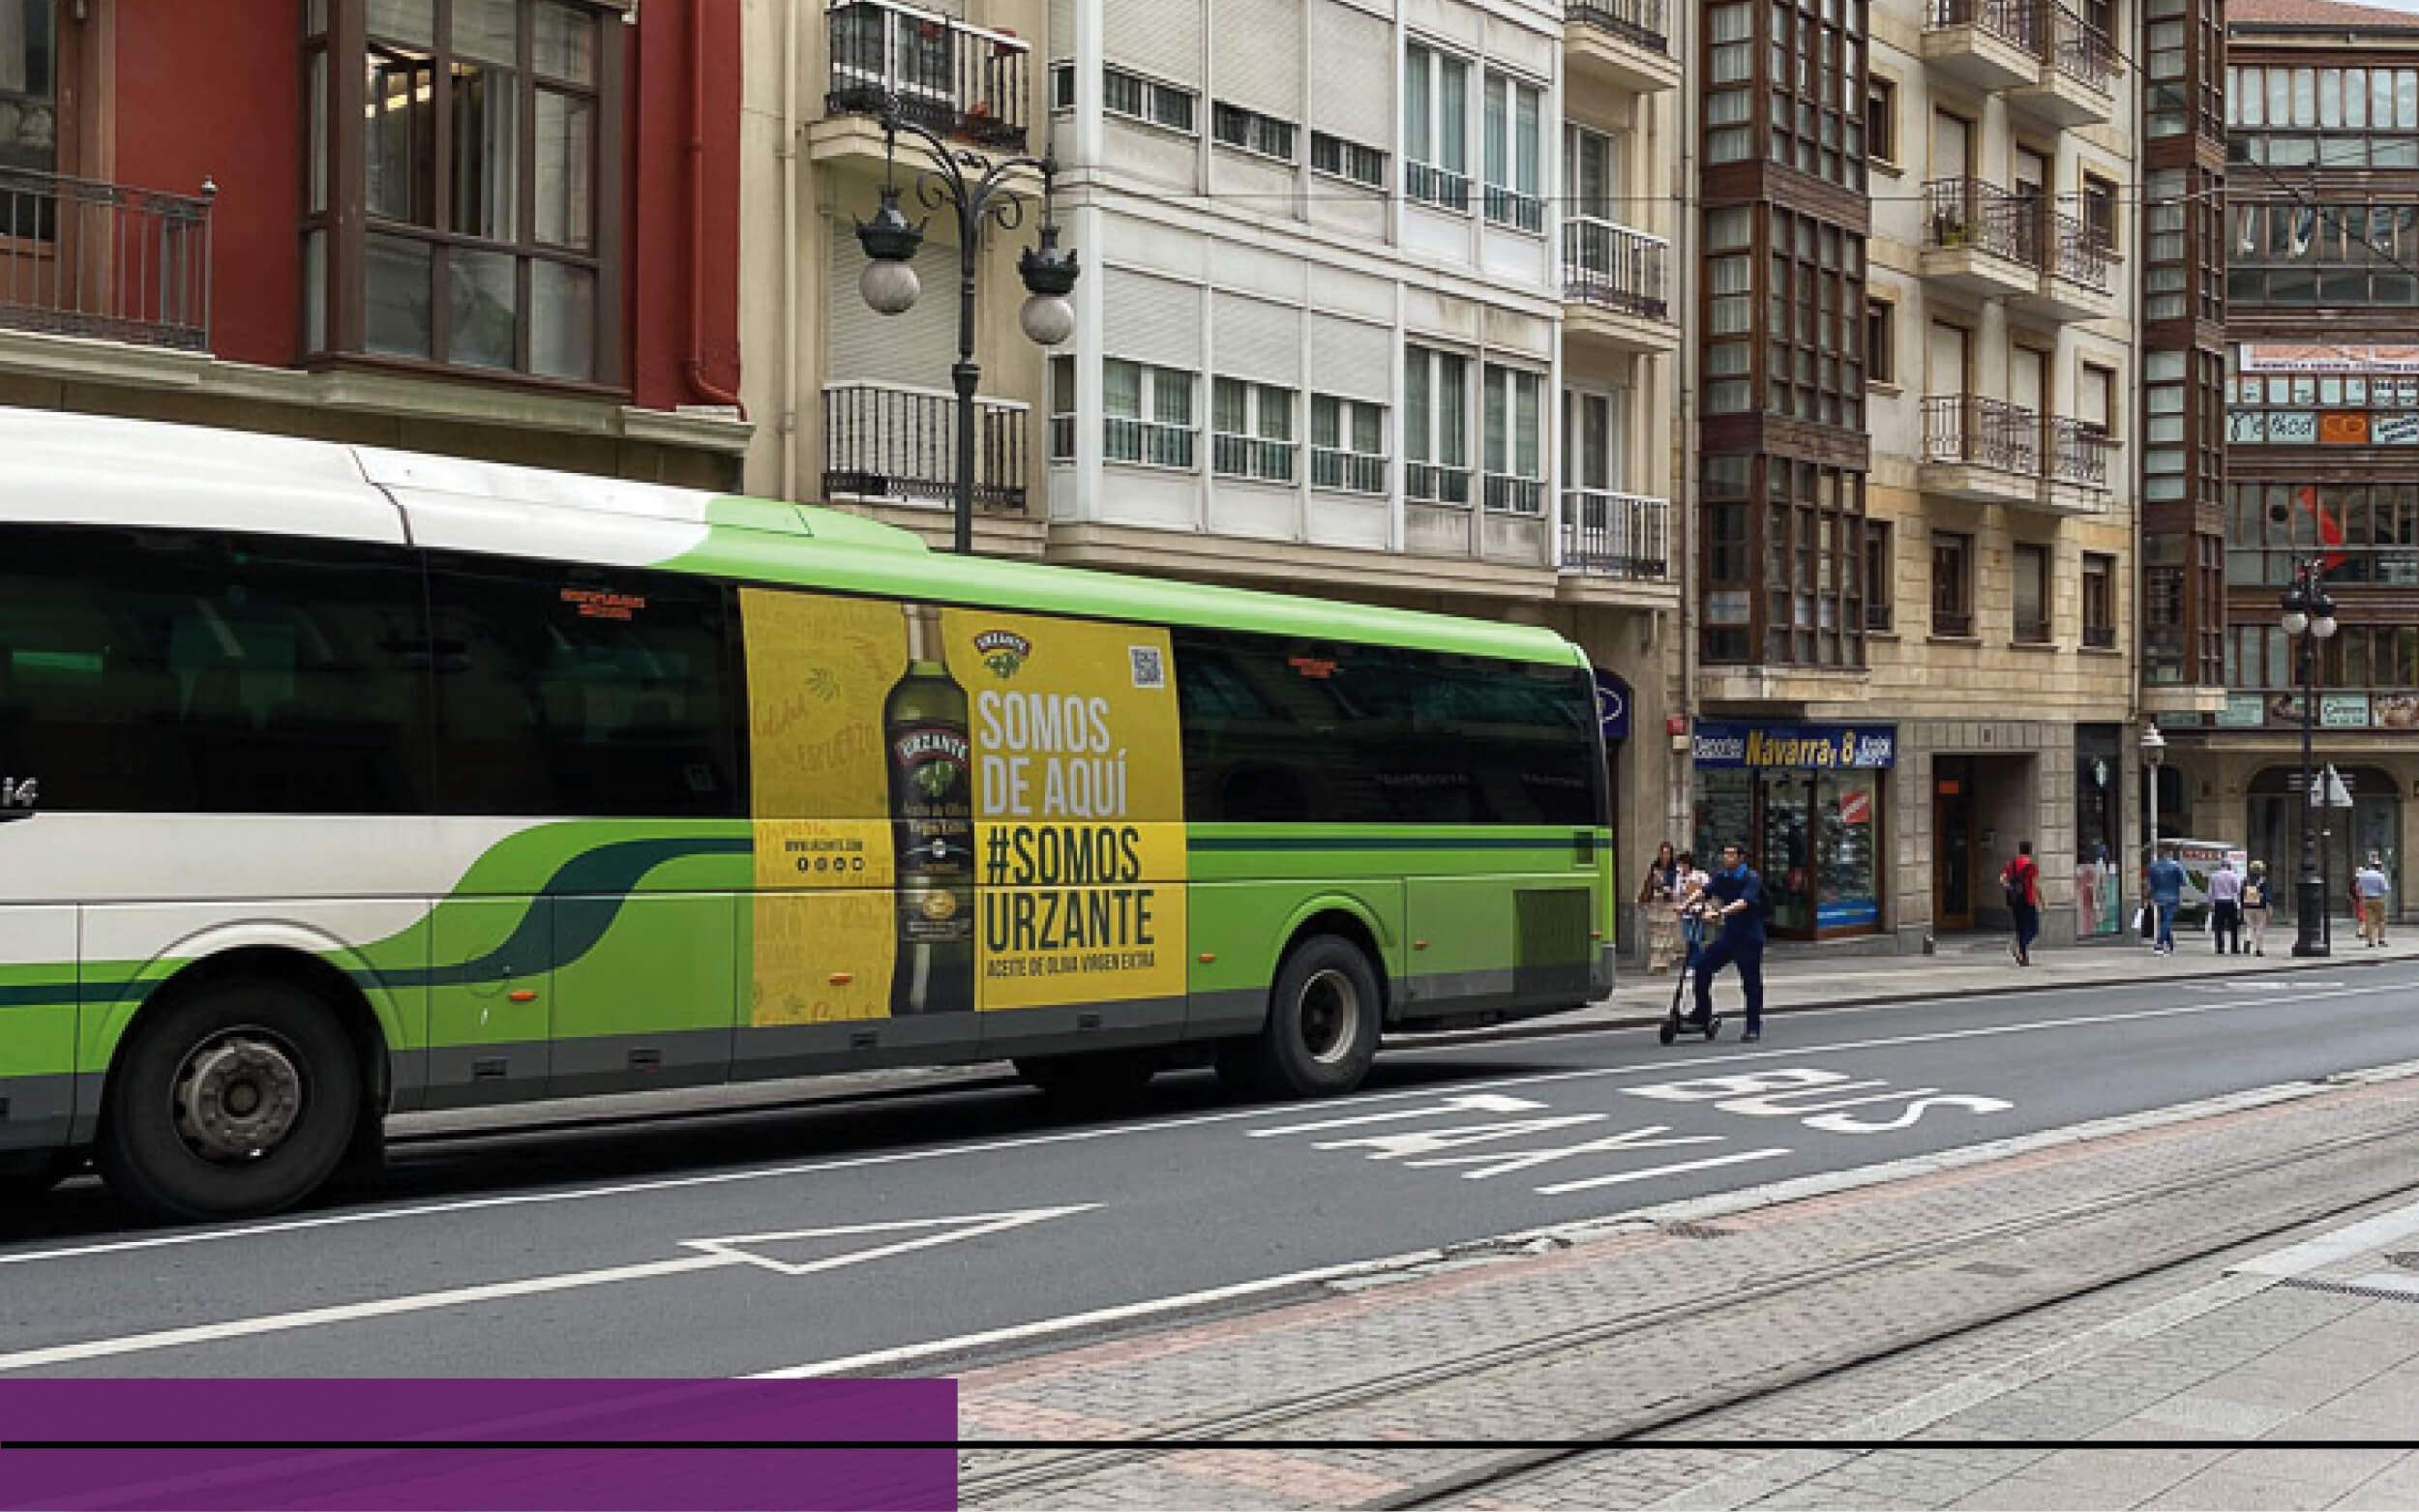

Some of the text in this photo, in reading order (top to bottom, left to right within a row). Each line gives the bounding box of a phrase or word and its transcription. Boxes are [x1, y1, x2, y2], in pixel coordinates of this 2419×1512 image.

[978, 691, 1109, 753] SOMOS
[1746, 729, 1837, 768] Navarra,
[1841, 729, 1856, 765] 8
[982, 749, 1127, 819] DE AQUÍ
[986, 825, 1141, 884] #SOMOS
[986, 889, 1154, 952] URZANTE
[1619, 1068, 2013, 1134] BUS
[1245, 1094, 1794, 1195] TAXI
